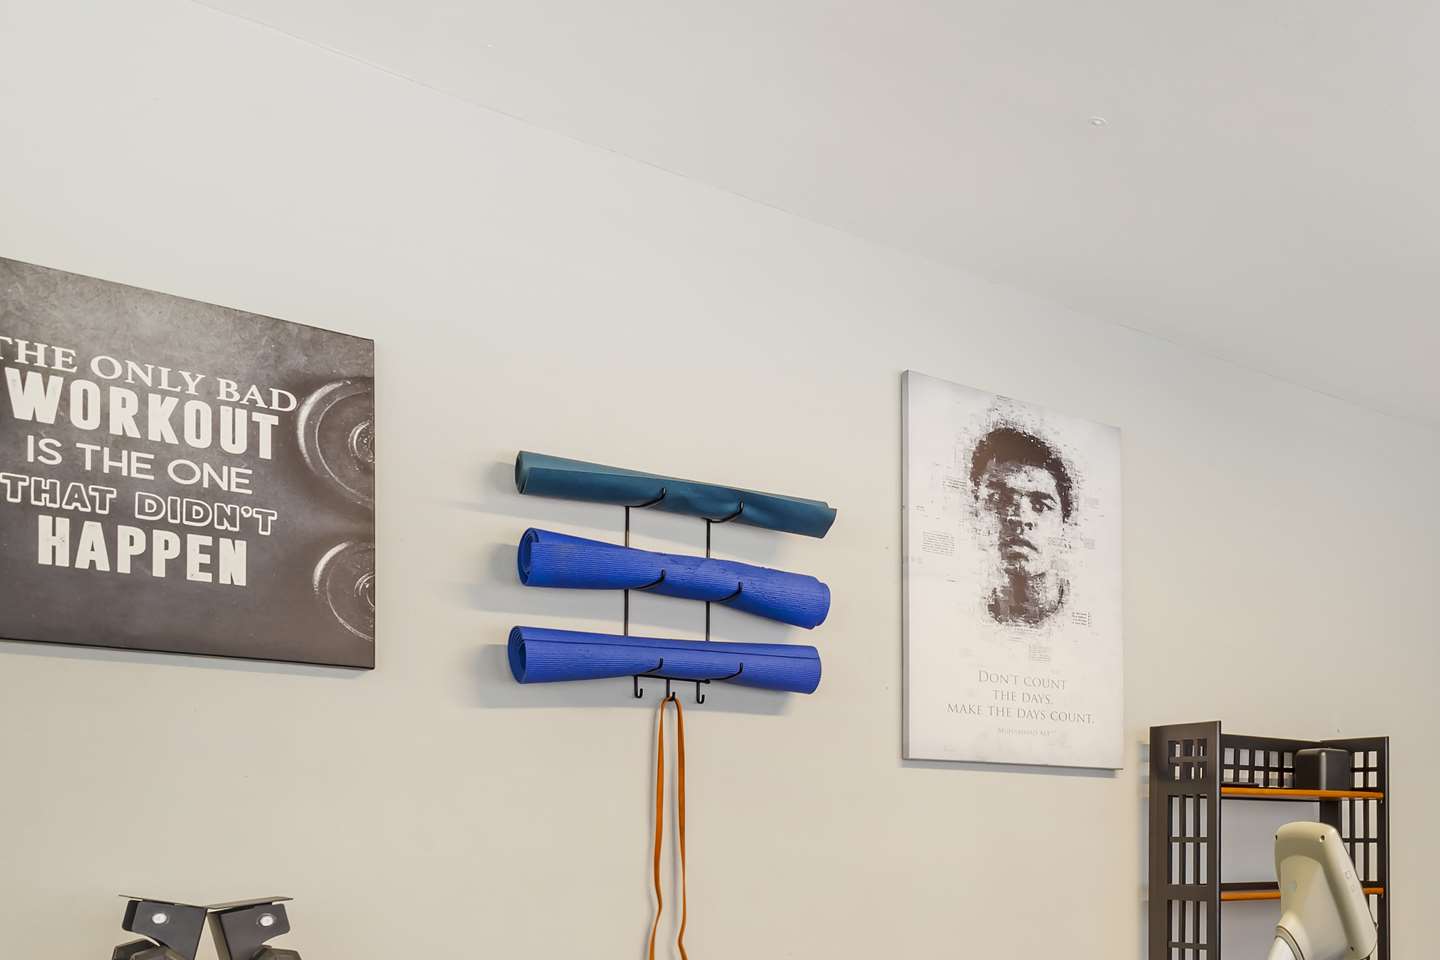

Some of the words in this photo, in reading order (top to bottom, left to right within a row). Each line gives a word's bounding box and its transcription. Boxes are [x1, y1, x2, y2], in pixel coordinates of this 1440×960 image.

[90, 355, 206, 395] ONLY
[216, 378, 297, 412] BAD
[5, 367, 279, 460] WORKOUT
[26, 435, 63, 465] IS
[75, 442, 154, 480] THE
[167, 460, 253, 495] ONE
[0, 473, 116, 514] THAT
[135, 492, 277, 536] DIDN'T
[38, 515, 247, 586] HAPPEN
[946, 703, 983, 715] MAKE
[988, 705, 1013, 718] THE
[1017, 707, 1047, 720] DAYS
[992, 689, 1016, 702] THE
[1023, 676, 1067, 690] COUNT
